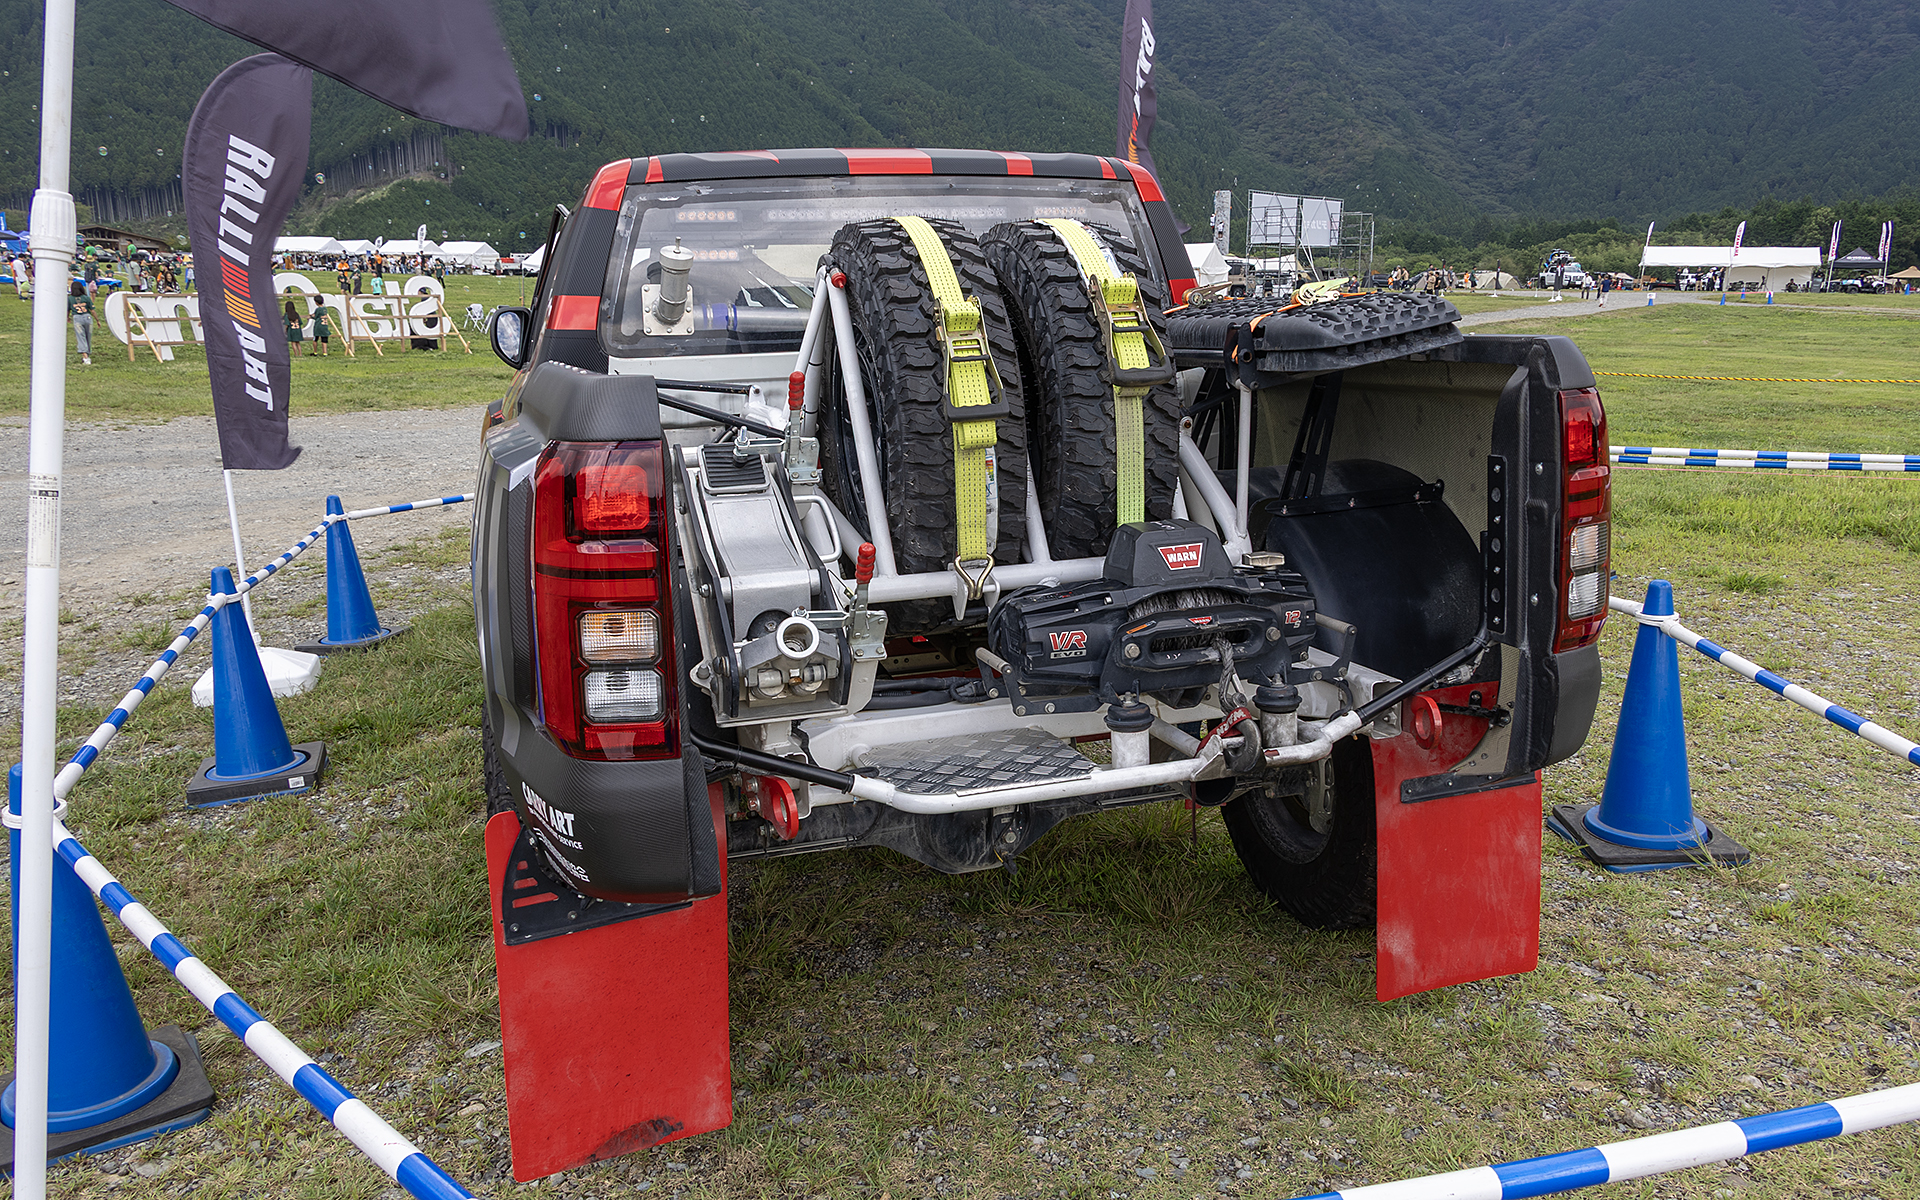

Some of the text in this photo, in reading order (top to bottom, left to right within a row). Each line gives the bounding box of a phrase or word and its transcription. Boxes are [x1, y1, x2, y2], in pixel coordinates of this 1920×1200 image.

[1166, 551, 1198, 563] WARN
[1285, 610, 1301, 624] 12
[1049, 630, 1088, 651] VR
[1052, 650, 1084, 658] EVO
[549, 805, 575, 837] ART
